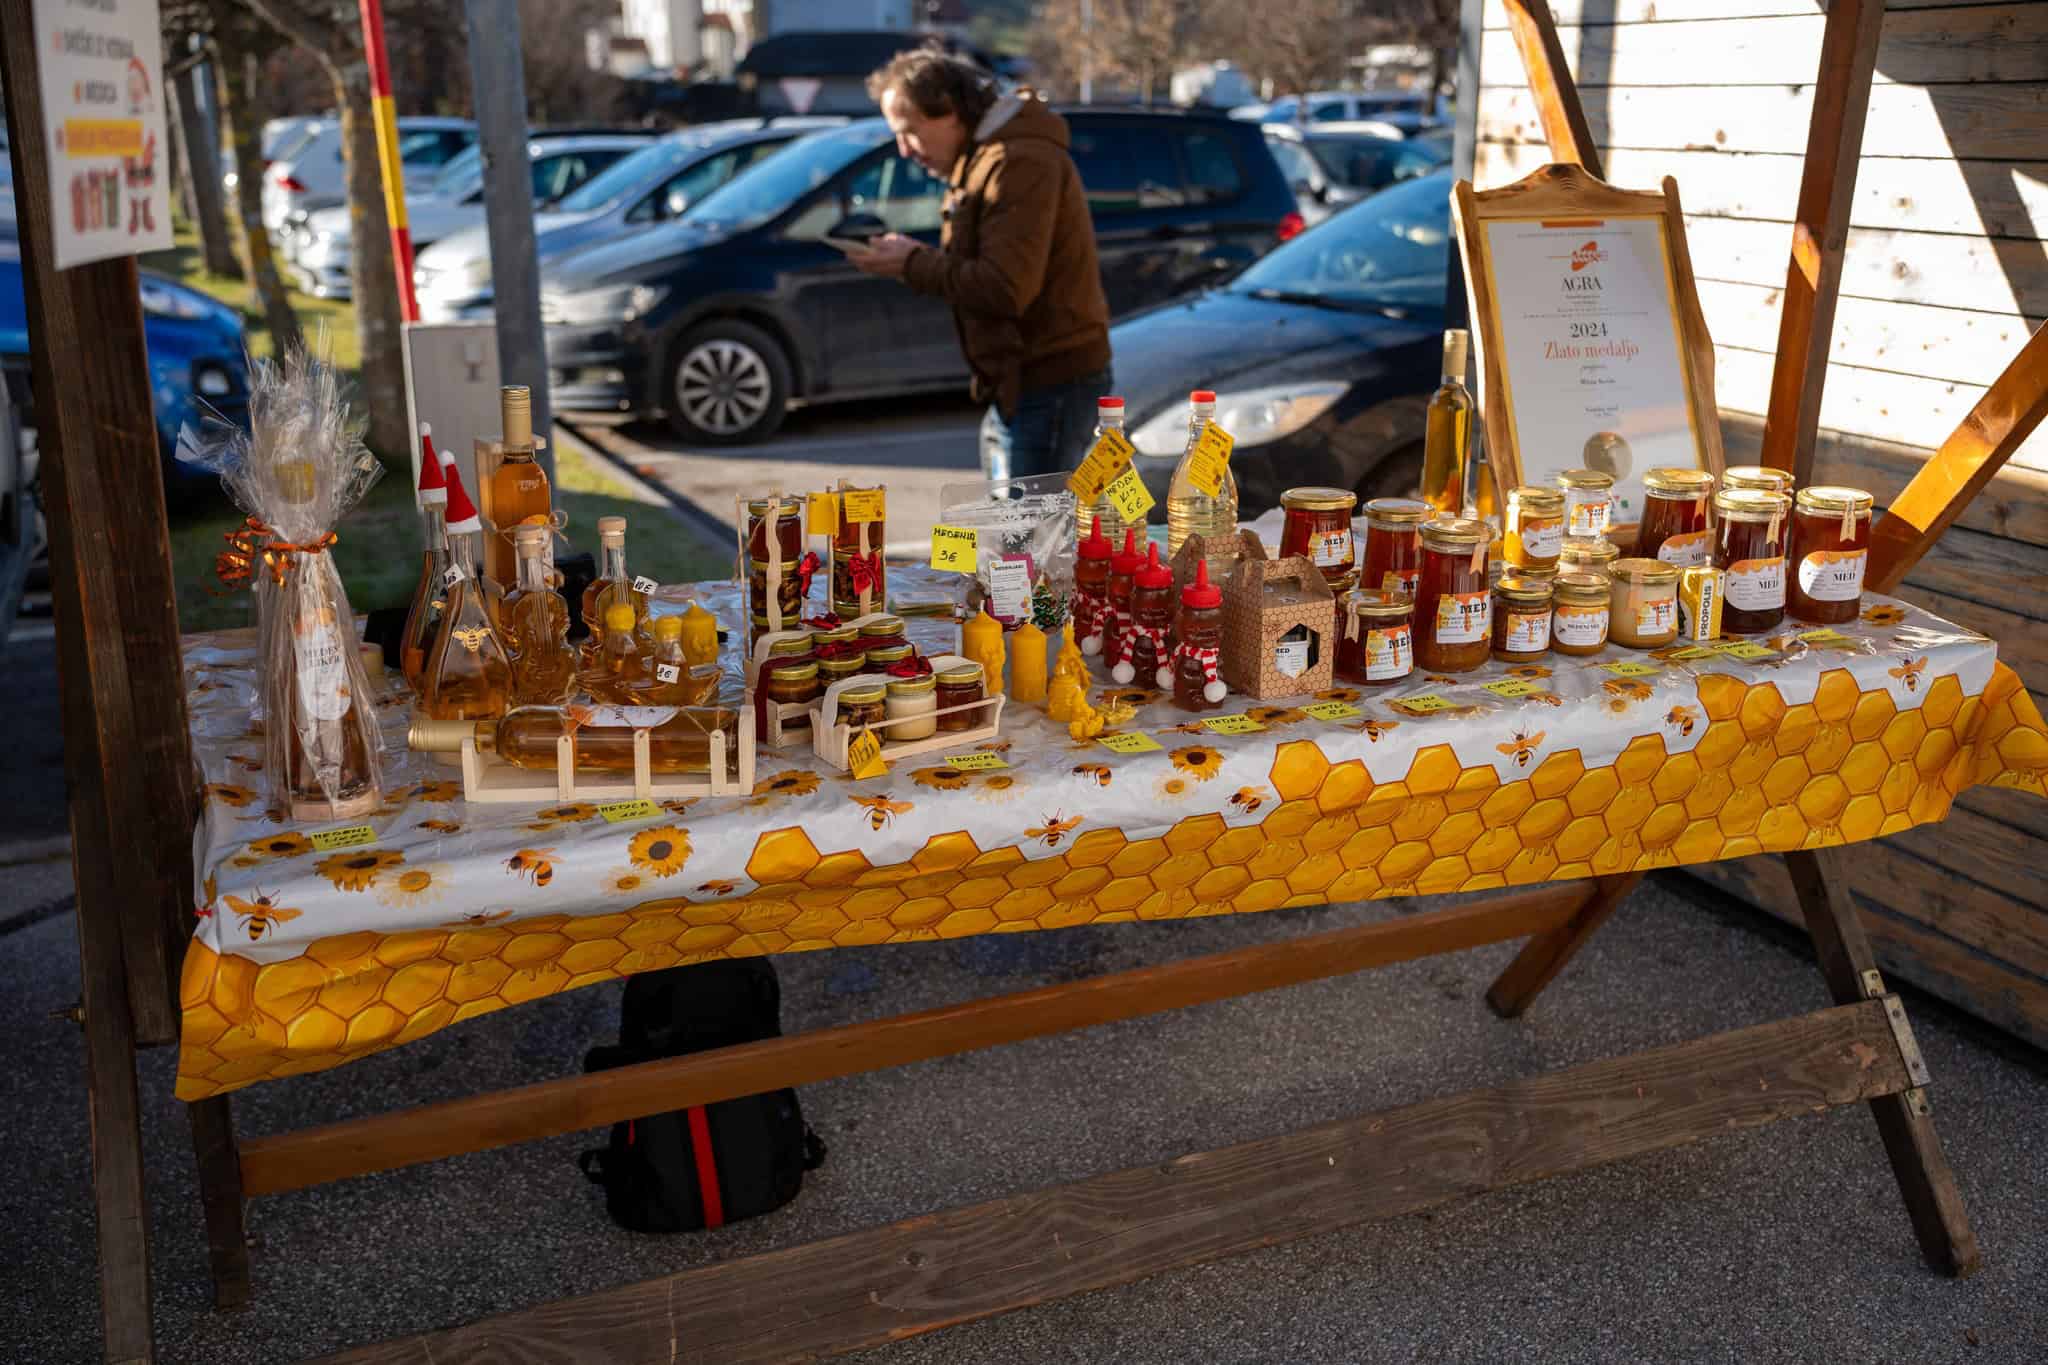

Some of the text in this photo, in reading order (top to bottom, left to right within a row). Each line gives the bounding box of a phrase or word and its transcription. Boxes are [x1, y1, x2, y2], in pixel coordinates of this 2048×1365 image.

[1561, 276, 1603, 292] AGRA
[1569, 321, 1608, 338] 2024
[1544, 340, 1580, 361] Zlato
[938, 550, 958, 563] 3€
[1832, 572, 1855, 582] MED
[1460, 602, 1487, 614] MED
[1700, 586, 1712, 637] PROPOLIS
